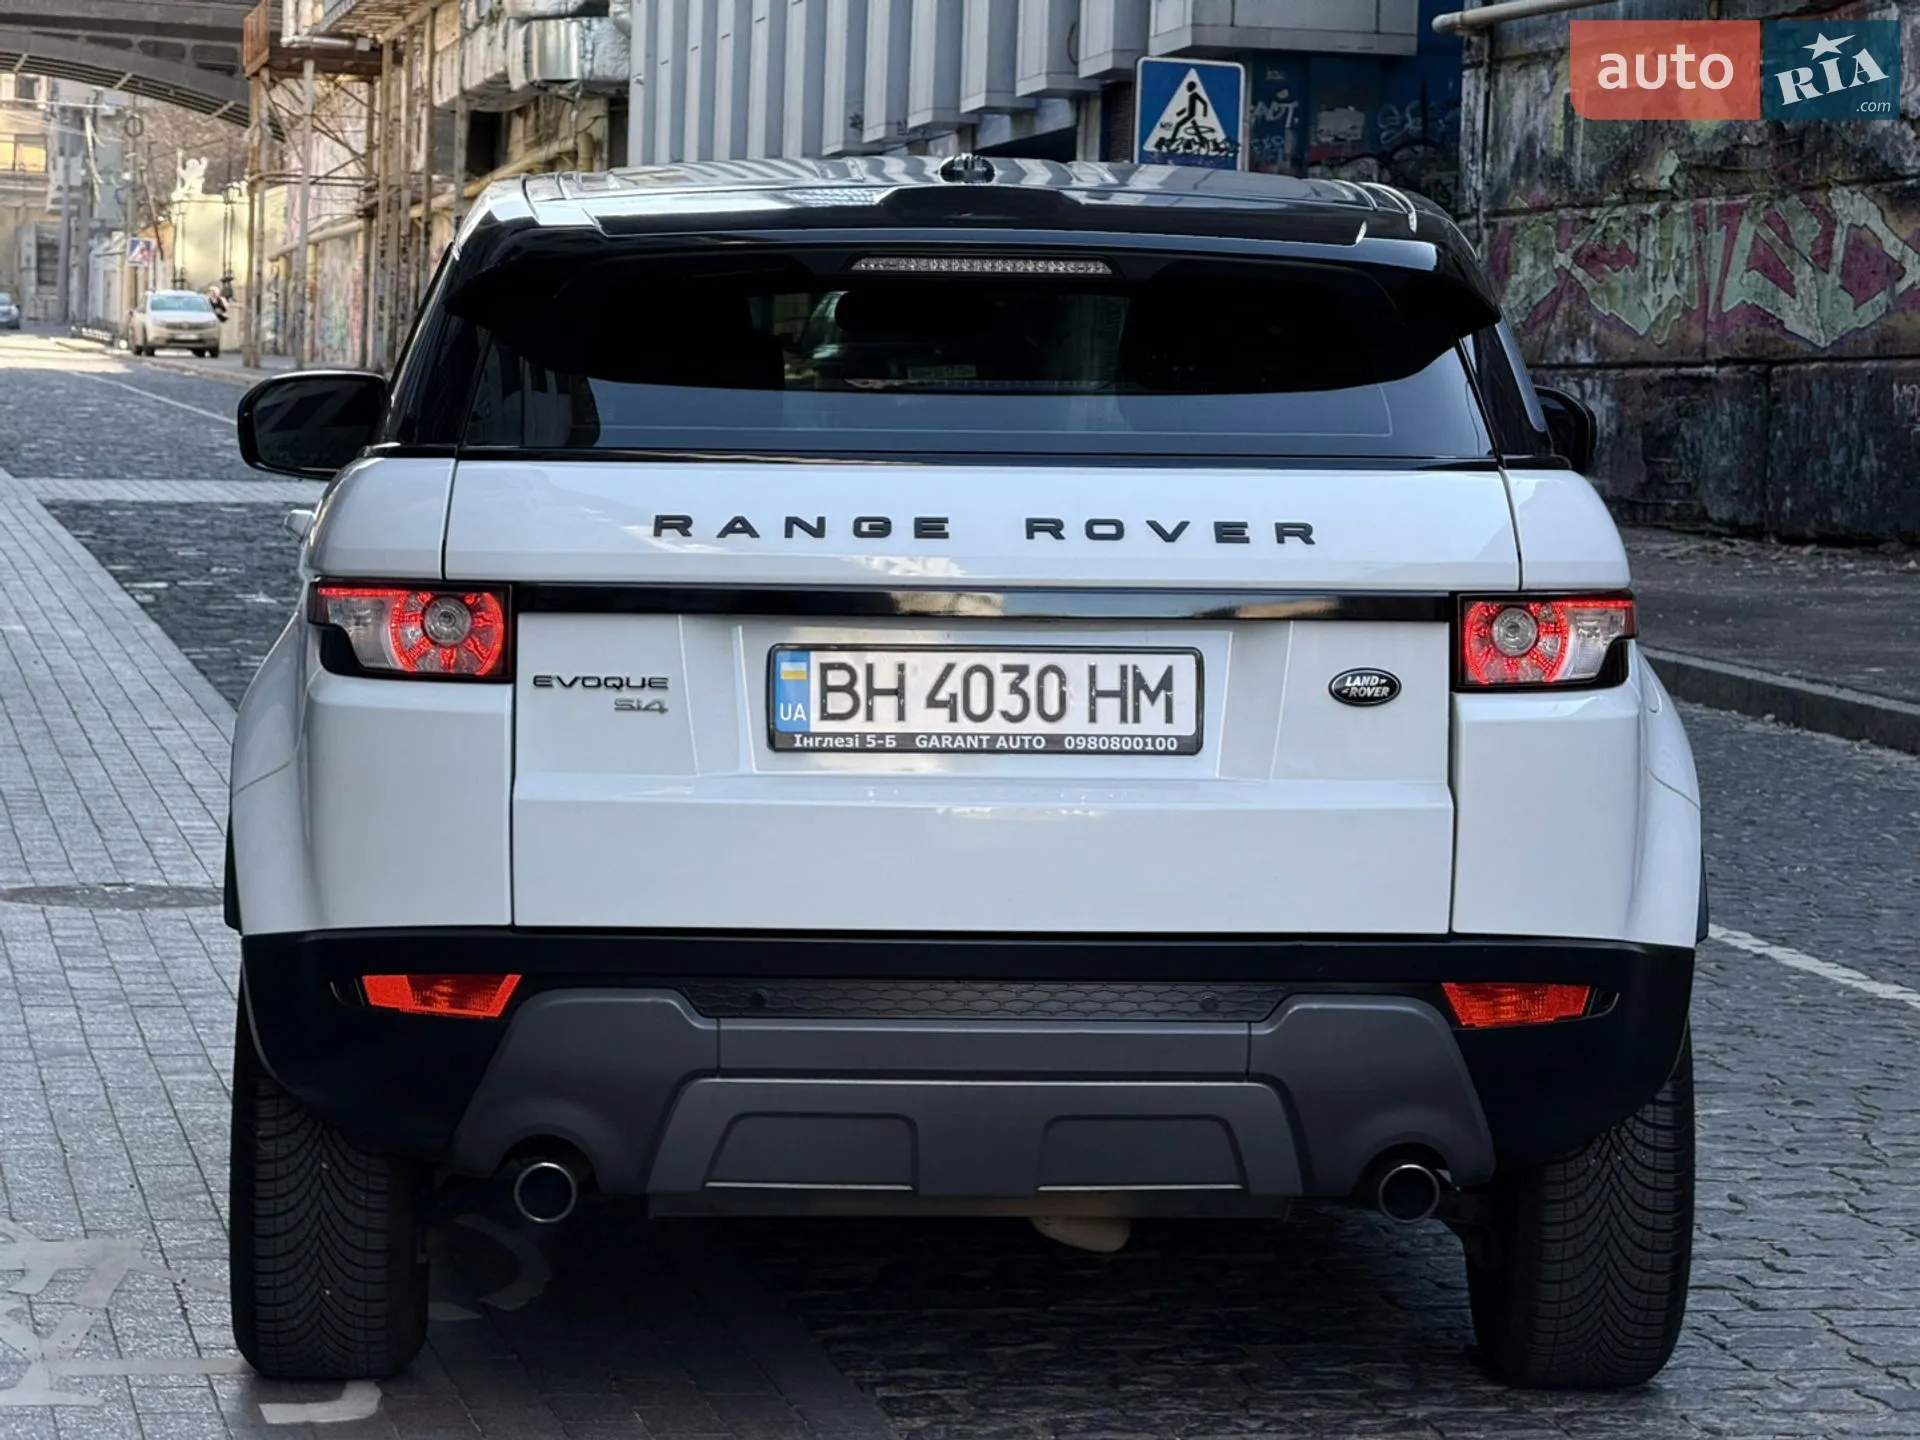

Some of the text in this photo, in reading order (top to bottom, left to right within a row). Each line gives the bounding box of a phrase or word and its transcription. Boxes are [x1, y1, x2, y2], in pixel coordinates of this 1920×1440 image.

[653, 514, 1316, 545] RANGE ROVER
[532, 674, 669, 692] EVOQUE
[1345, 675, 1380, 687] LAND
[819, 662, 1173, 724] BH 4030 HM
[1348, 686, 1390, 697] ROVER
[780, 702, 807, 721] UA
[793, 734, 897, 748] Інглезі 5-Б
[915, 734, 1046, 750] GARANT AUTO
[1064, 736, 1178, 751] 0980800100
